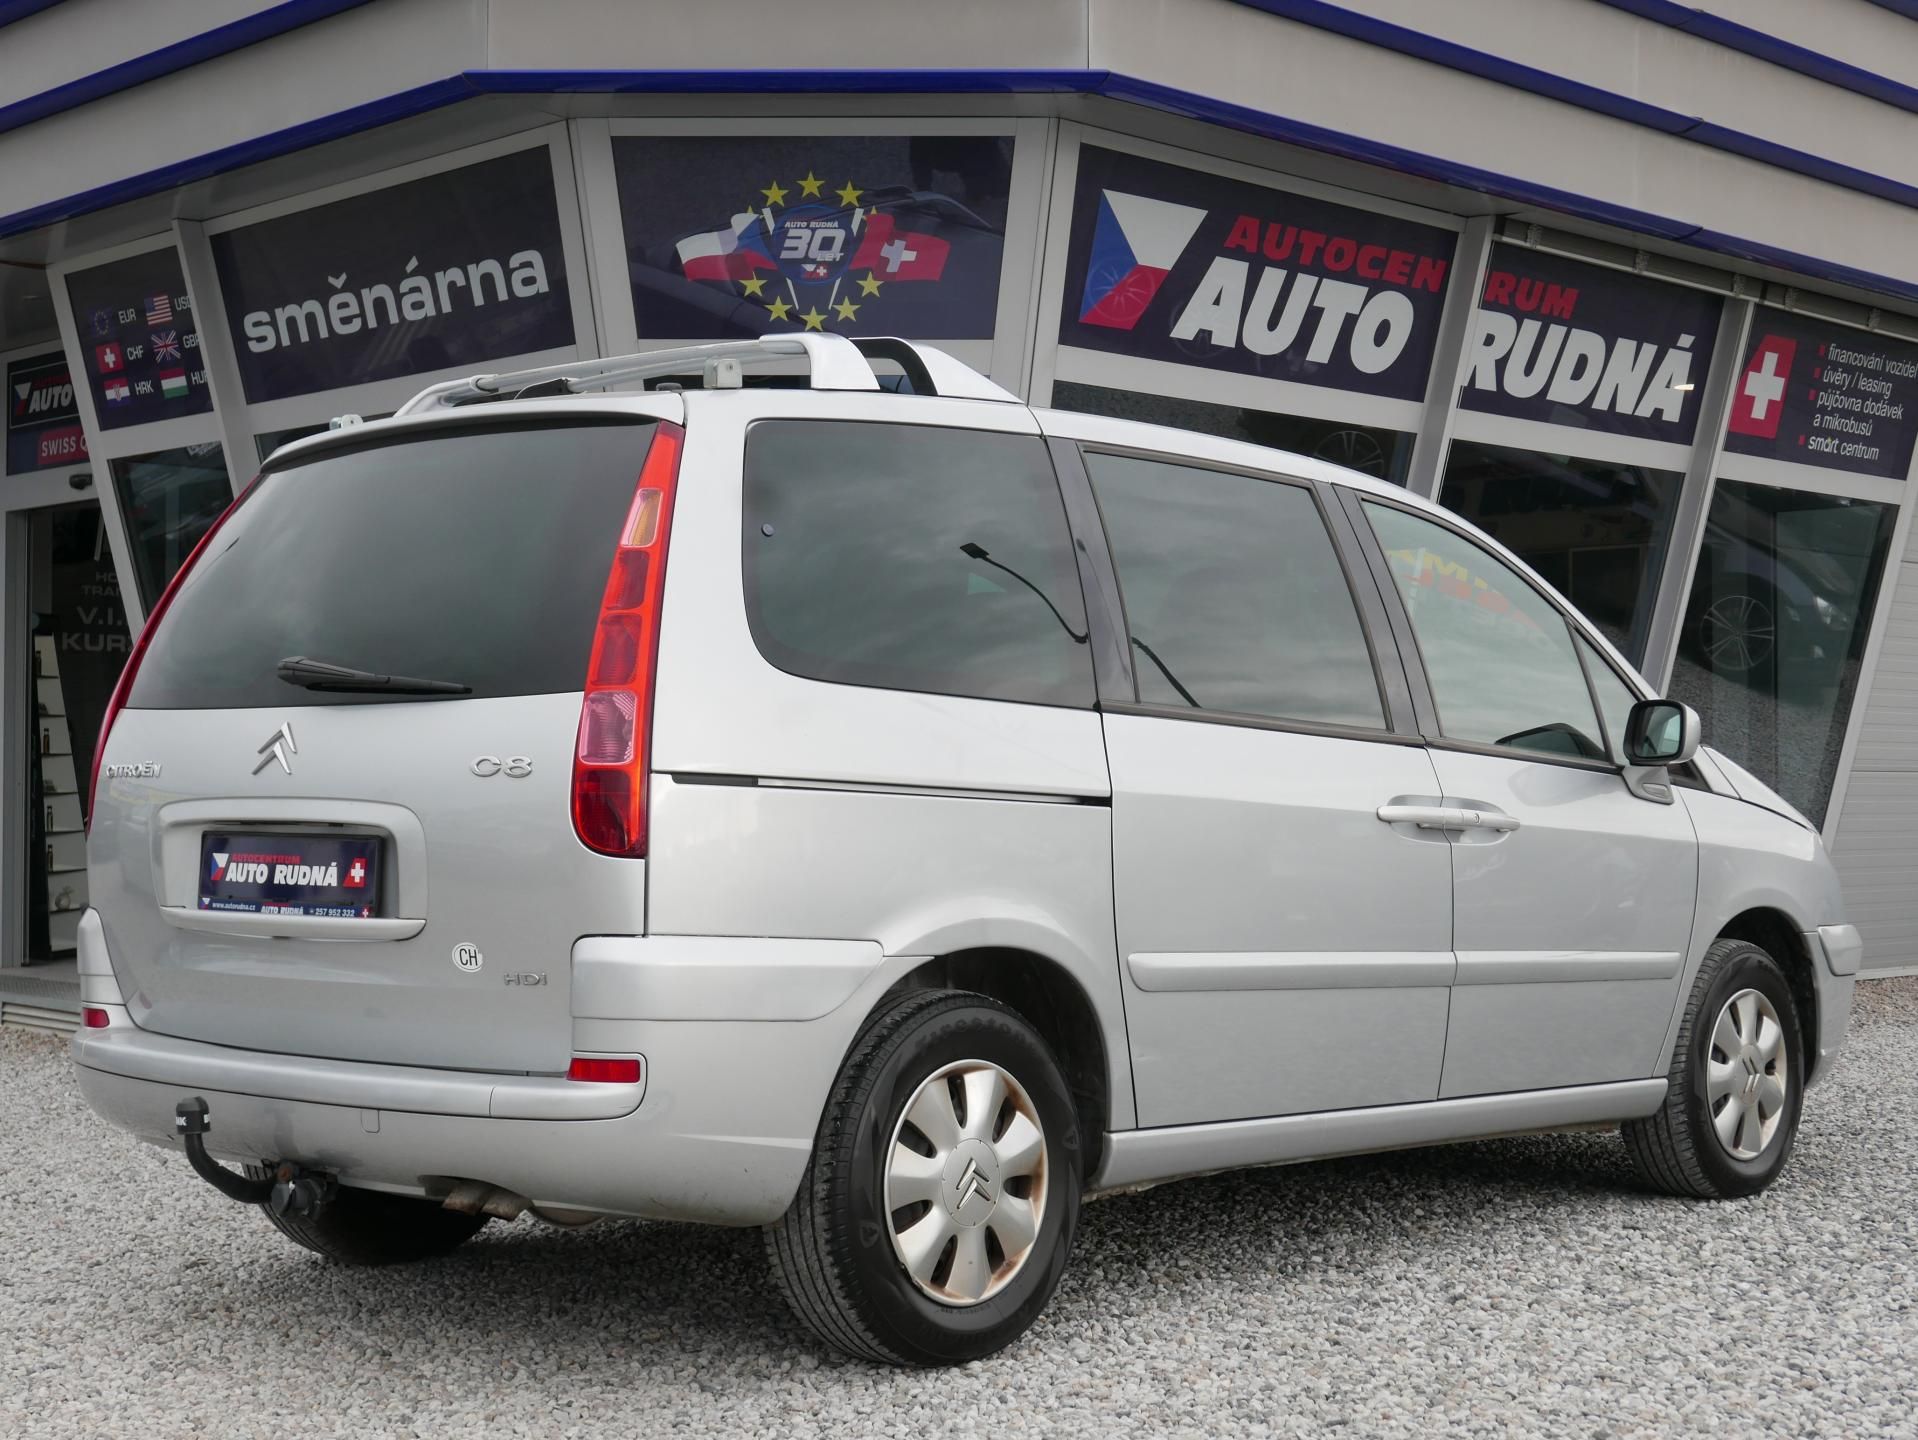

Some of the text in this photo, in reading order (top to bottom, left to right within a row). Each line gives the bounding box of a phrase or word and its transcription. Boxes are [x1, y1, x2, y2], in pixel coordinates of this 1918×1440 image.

[780, 229, 846, 258] 30
[243, 250, 549, 352] směnárna
[118, 308, 137, 323] EUR
[1169, 256, 1696, 422] AUTO RUDNÁ
[126, 345, 144, 360] CHF
[1828, 343, 1918, 379] financování vozidel
[135, 380, 154, 395] HRK
[1823, 366, 1852, 390] úvěry
[1858, 372, 1893, 399] leasing
[28, 383, 73, 414] AUTO
[1817, 388, 1904, 420] půjčovna dodávek
[1813, 413, 1873, 436] a mikrobusů
[41, 436, 76, 457] SWISS
[1808, 435, 1879, 460] smart centrum
[106, 760, 162, 778] CITROËN
[470, 755, 533, 778] C8
[225, 862, 338, 887] AUTO RUDNÁ
[212, 902, 256, 911] www.autorudna.cz
[261, 905, 279, 915] AUTO
[315, 907, 328, 916] 257
[328, 908, 341, 917] 952
[342, 908, 355, 917] 332
[459, 948, 479, 967] CH
[503, 972, 548, 986] HDi
